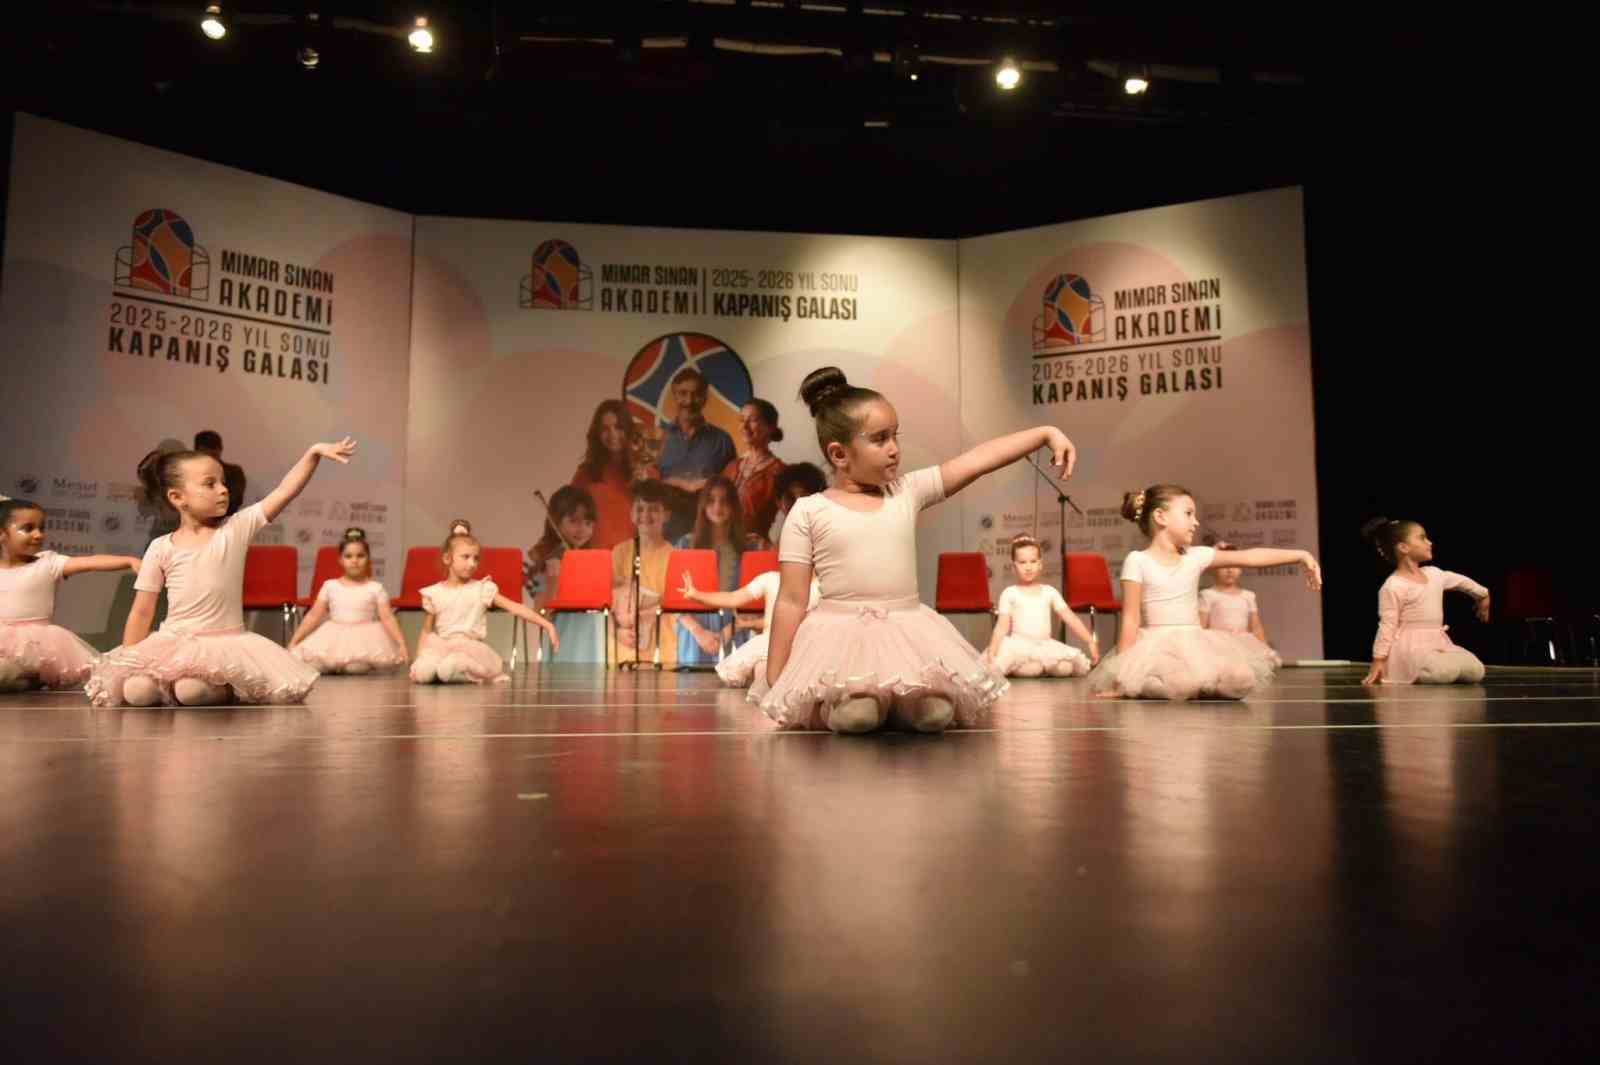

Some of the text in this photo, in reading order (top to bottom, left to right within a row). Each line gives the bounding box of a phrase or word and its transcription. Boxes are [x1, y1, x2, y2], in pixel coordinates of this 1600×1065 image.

[758, 270, 794, 289] 2026
[798, 272, 818, 291] YIL
[821, 273, 859, 292] SONU
[713, 292, 858, 322] KAPANIŞ GALASI
[1115, 304, 1221, 341] AKADEMİ
[110, 302, 330, 359] 2025-2026 YIL SONU
[108, 326, 329, 385] KAPANIŞ GALASI
[1032, 345, 1223, 382] 2025-2026 YIL SONU
[1032, 367, 1223, 405] KAPANIŞ GALASI
